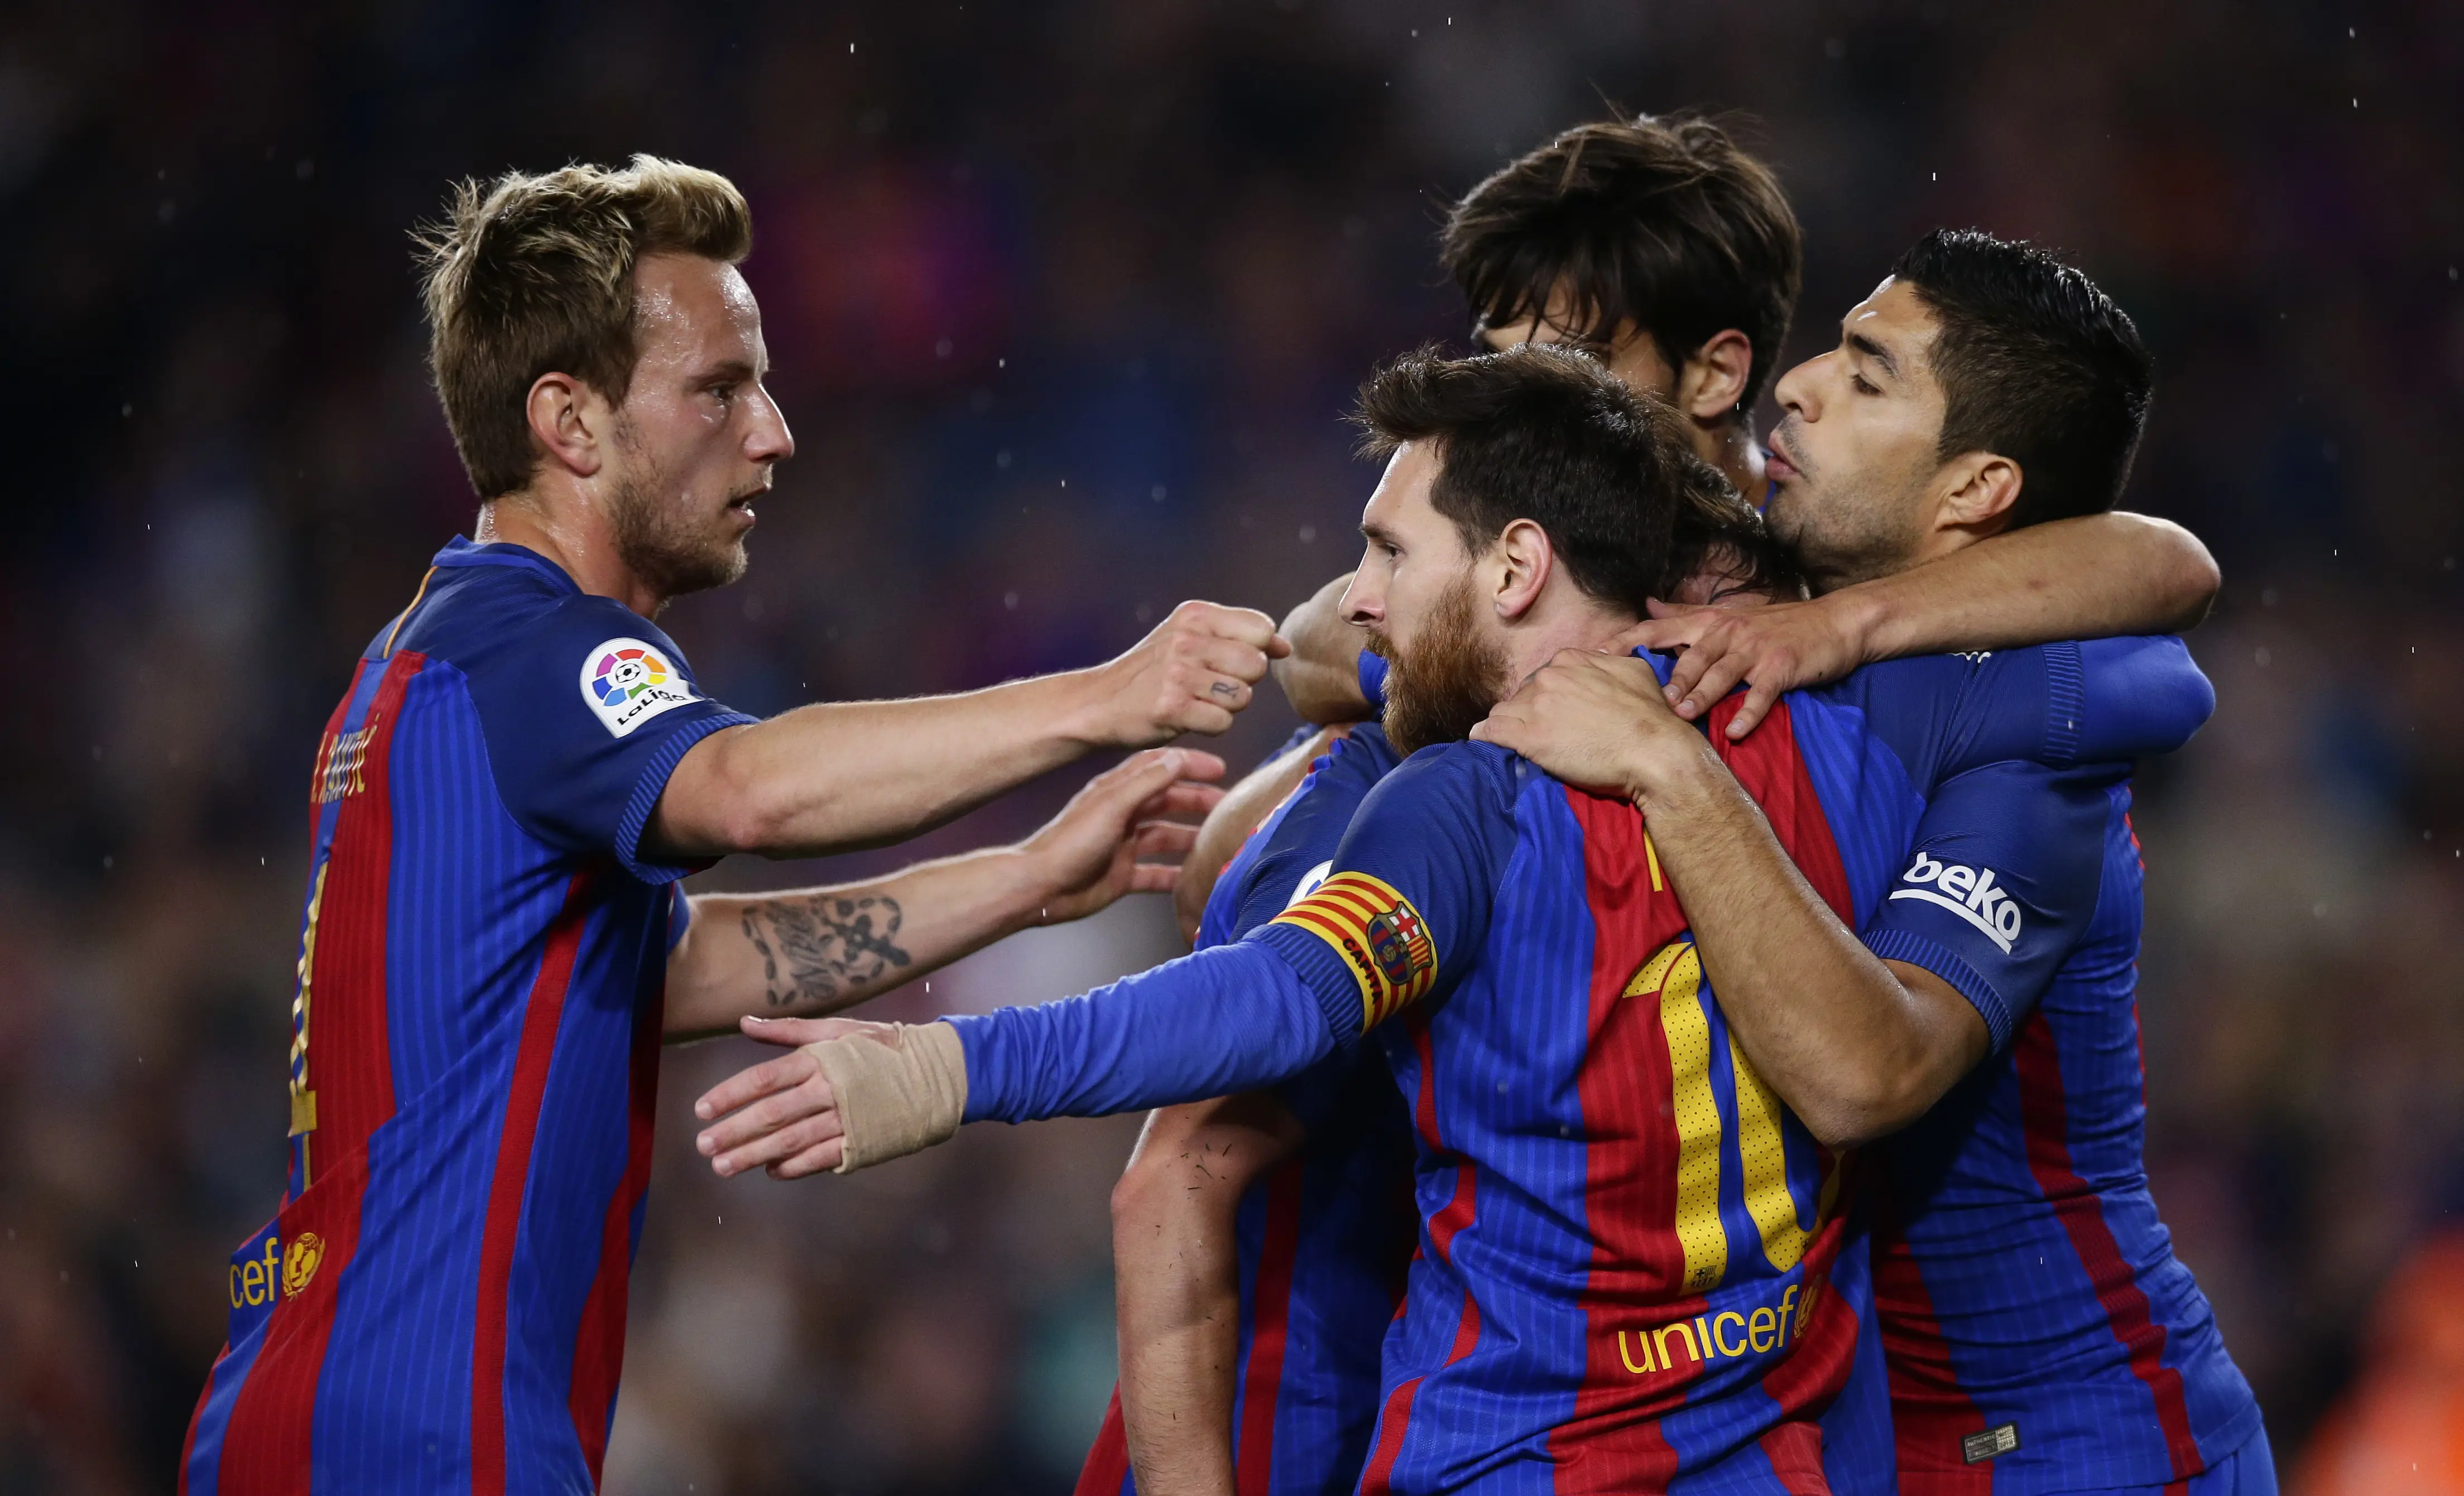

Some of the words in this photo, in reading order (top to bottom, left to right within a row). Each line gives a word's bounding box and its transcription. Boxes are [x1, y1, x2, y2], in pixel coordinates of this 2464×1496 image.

[617, 689, 687, 725] LaLiga
[1903, 852, 2021, 941] beko
[1622, 942, 1842, 1296] 10
[229, 1237, 279, 1309] cef
[1619, 1285, 1798, 1374] unicef
